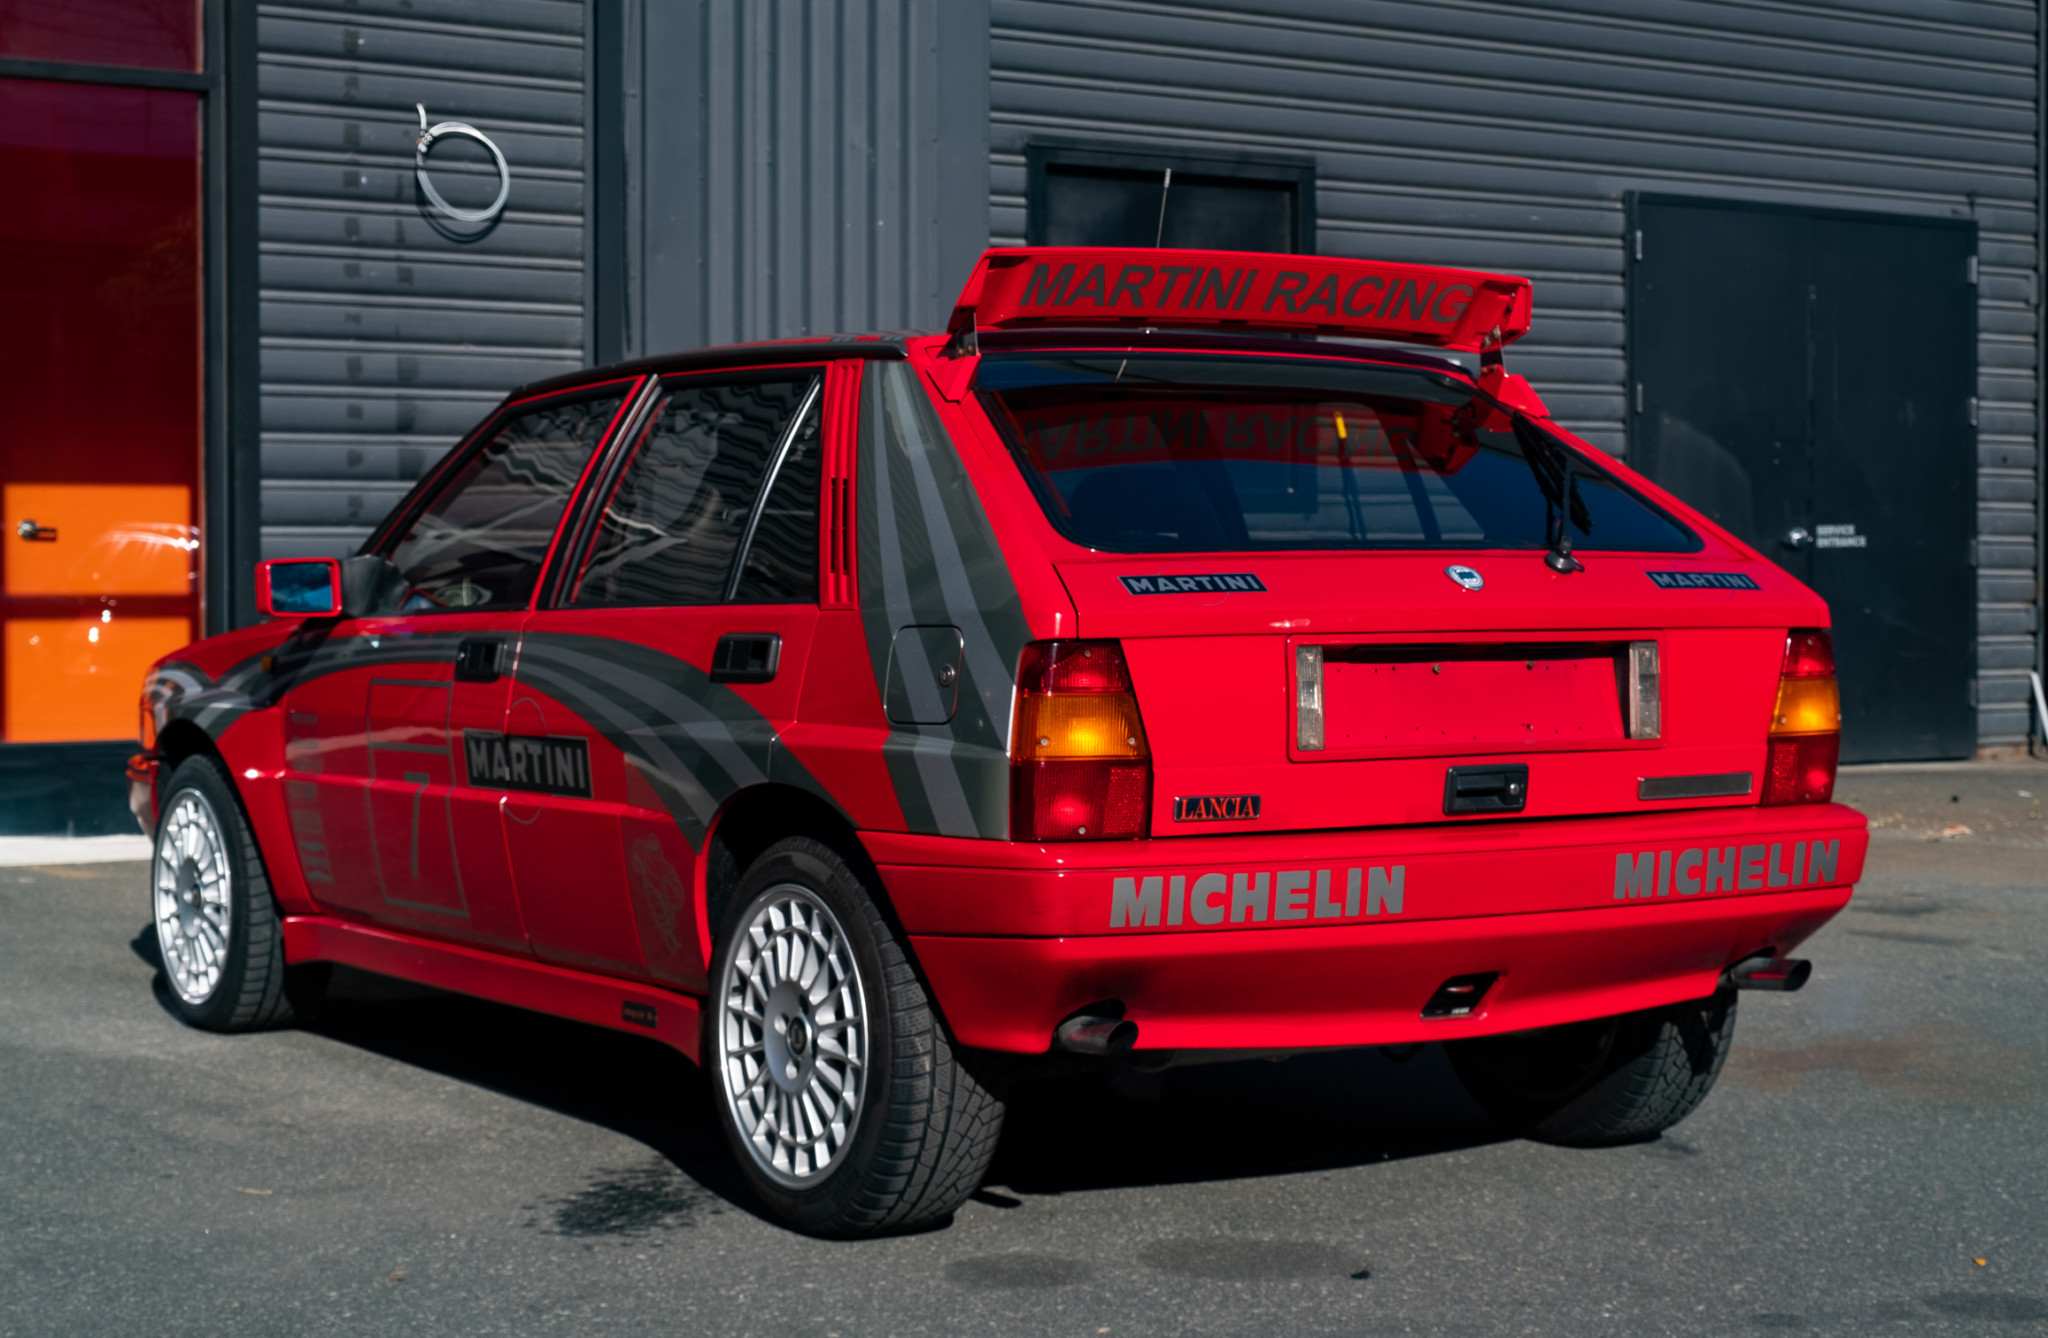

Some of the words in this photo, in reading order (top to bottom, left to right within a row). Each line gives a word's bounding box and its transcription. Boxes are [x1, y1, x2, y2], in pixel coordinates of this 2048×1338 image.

[1019, 263, 1259, 311] MARTINI
[1262, 270, 1474, 324] RACING
[1127, 575, 1261, 593] MARTINI
[1651, 573, 1756, 588] MARTINI
[468, 738, 587, 790] MARTINI
[403, 770, 431, 880] 7
[1180, 796, 1256, 820] LANCIA
[1109, 865, 1406, 928] MICHELIN
[1613, 839, 1841, 900] MICHELIN
